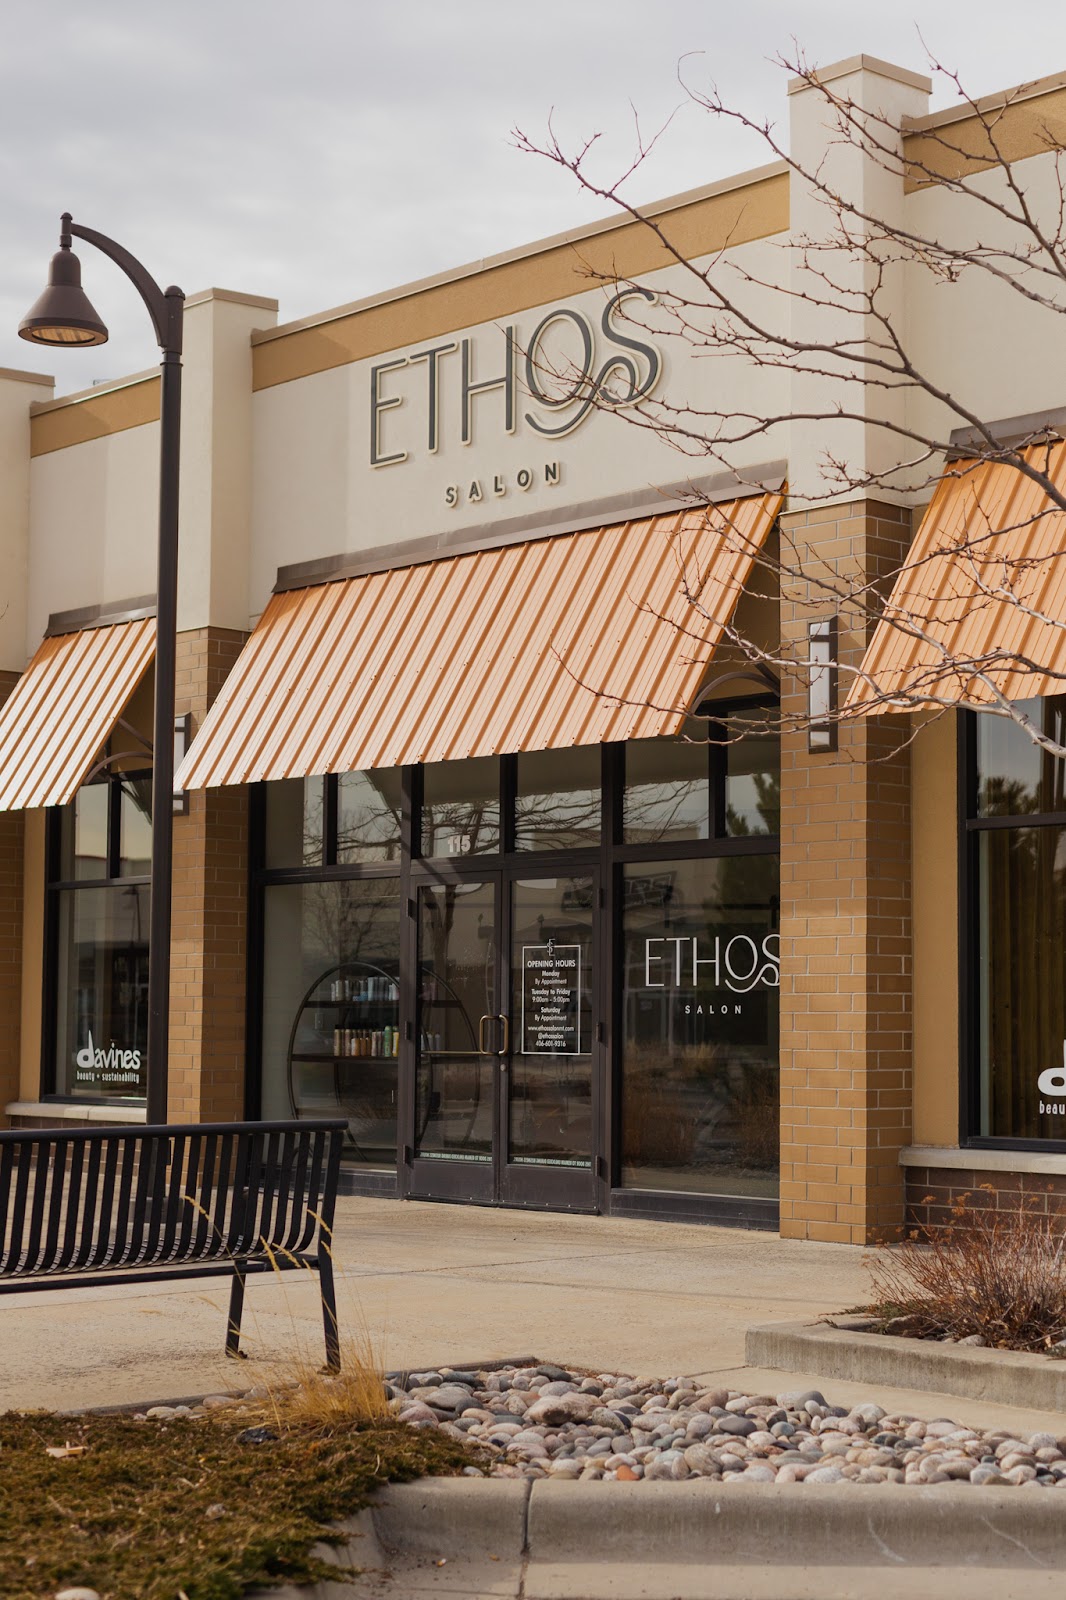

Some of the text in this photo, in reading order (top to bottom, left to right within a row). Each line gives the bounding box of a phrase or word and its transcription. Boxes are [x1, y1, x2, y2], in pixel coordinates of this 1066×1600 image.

[370, 286, 661, 467] ETHOS
[445, 461, 560, 507] SALON
[448, 834, 471, 852] 115
[527, 960, 553, 968] OPENING
[531, 988, 549, 996] Tuesday
[557, 988, 570, 996] Friday
[685, 1005, 742, 1014] SALON
[76, 1029, 141, 1070] davines
[76, 1070, 95, 1082] beauty
[101, 1071, 140, 1084] sustainability
